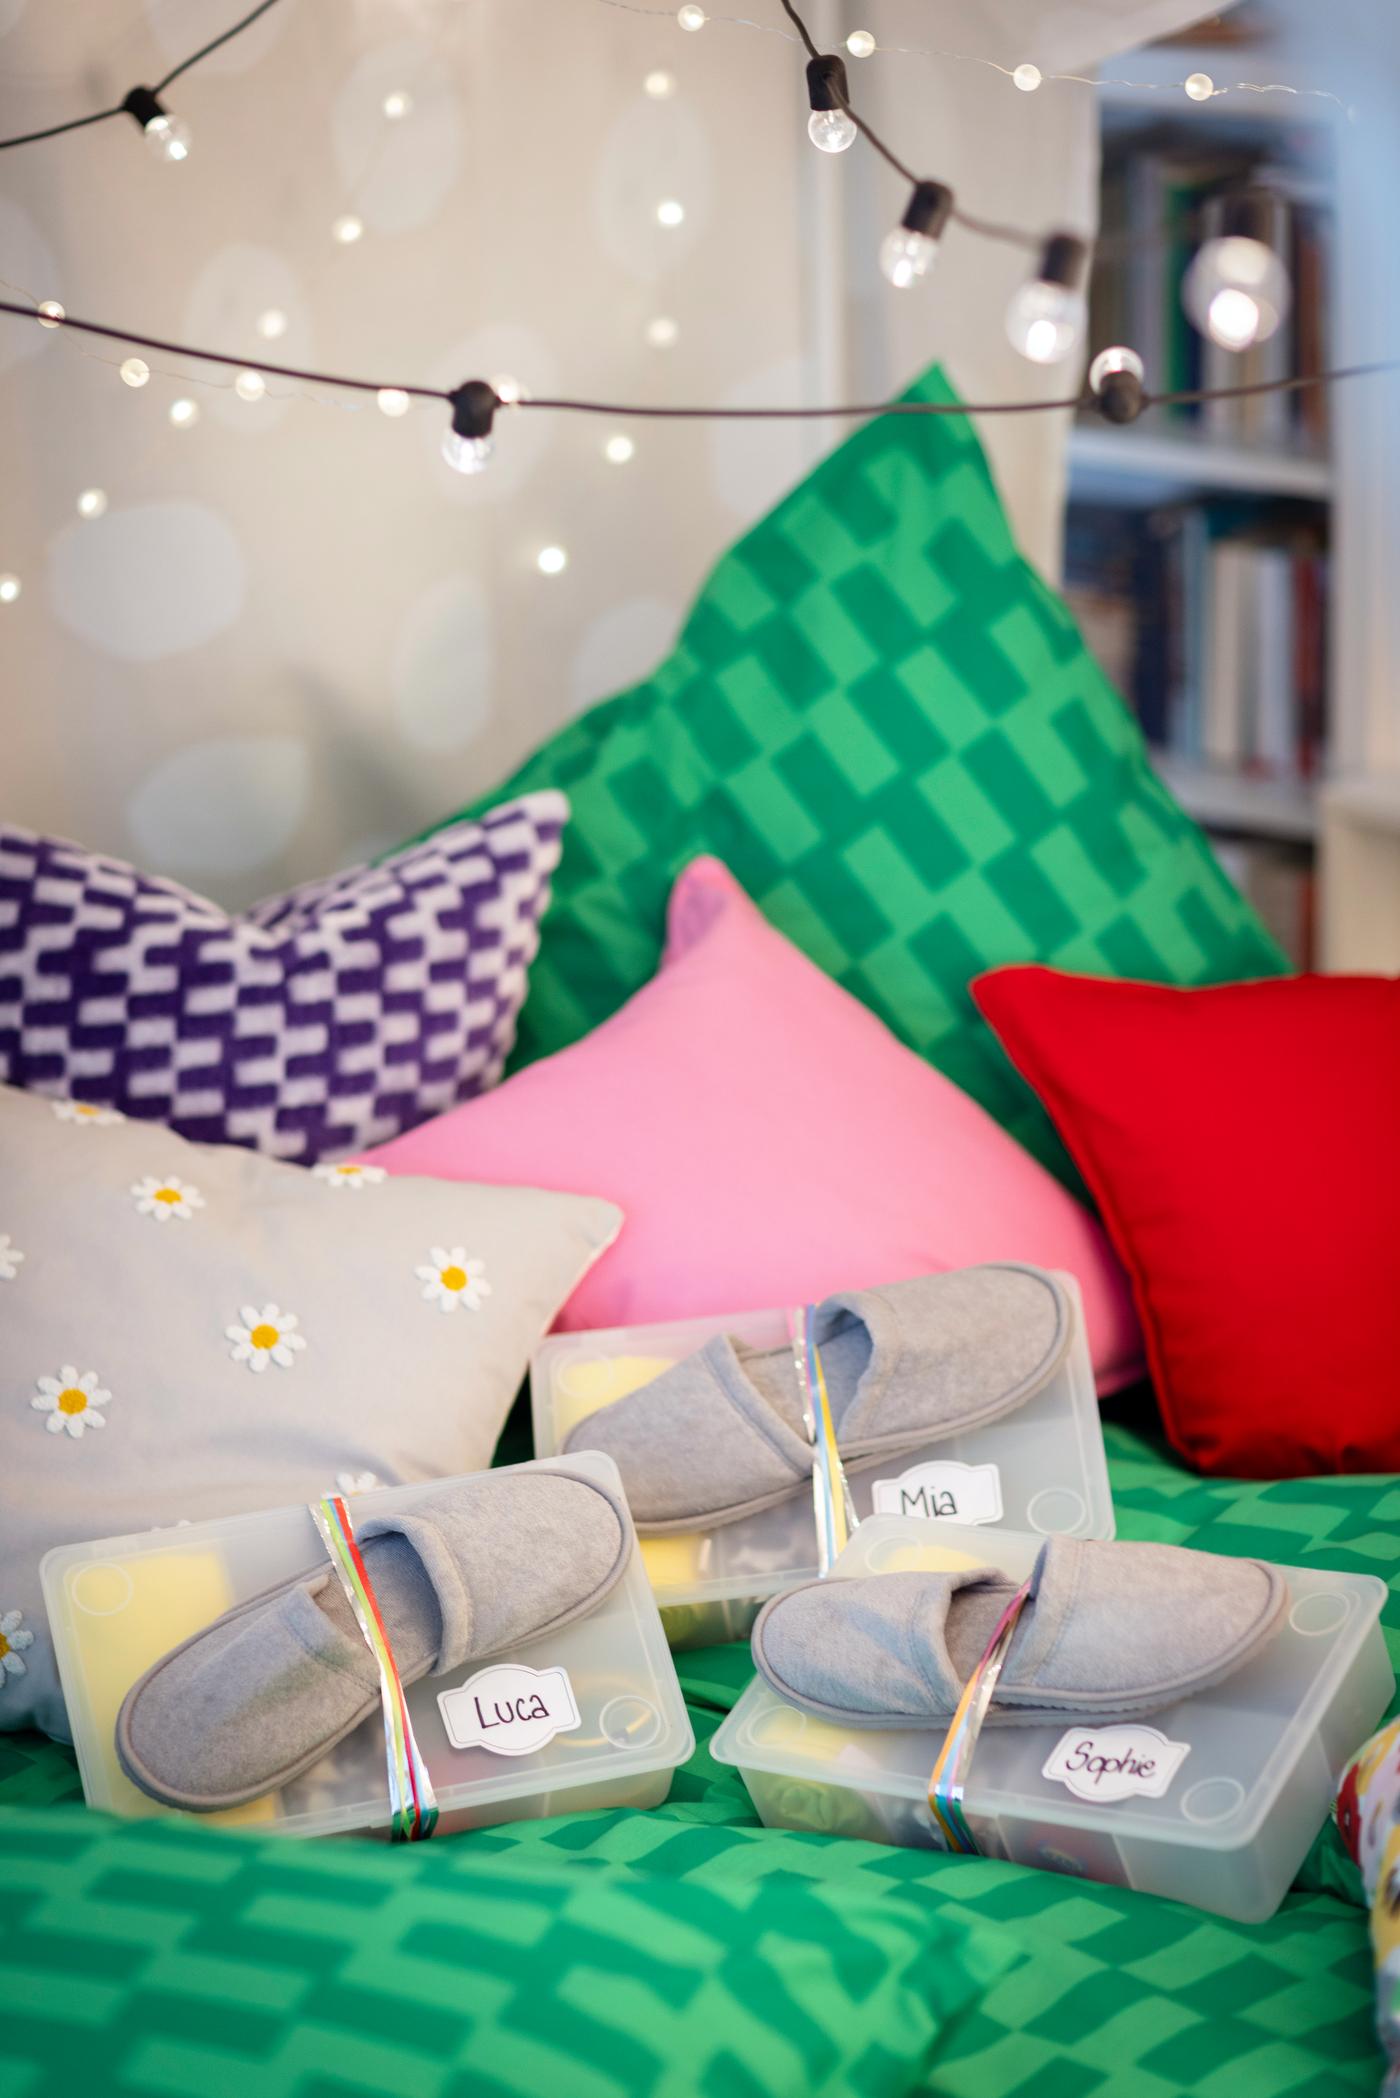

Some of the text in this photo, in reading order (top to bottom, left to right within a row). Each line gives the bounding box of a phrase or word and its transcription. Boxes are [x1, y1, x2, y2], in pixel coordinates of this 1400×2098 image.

[901, 1486, 958, 1517] Mia
[474, 1694, 550, 1729] Luca
[1065, 1741, 1156, 1785] Sophie
